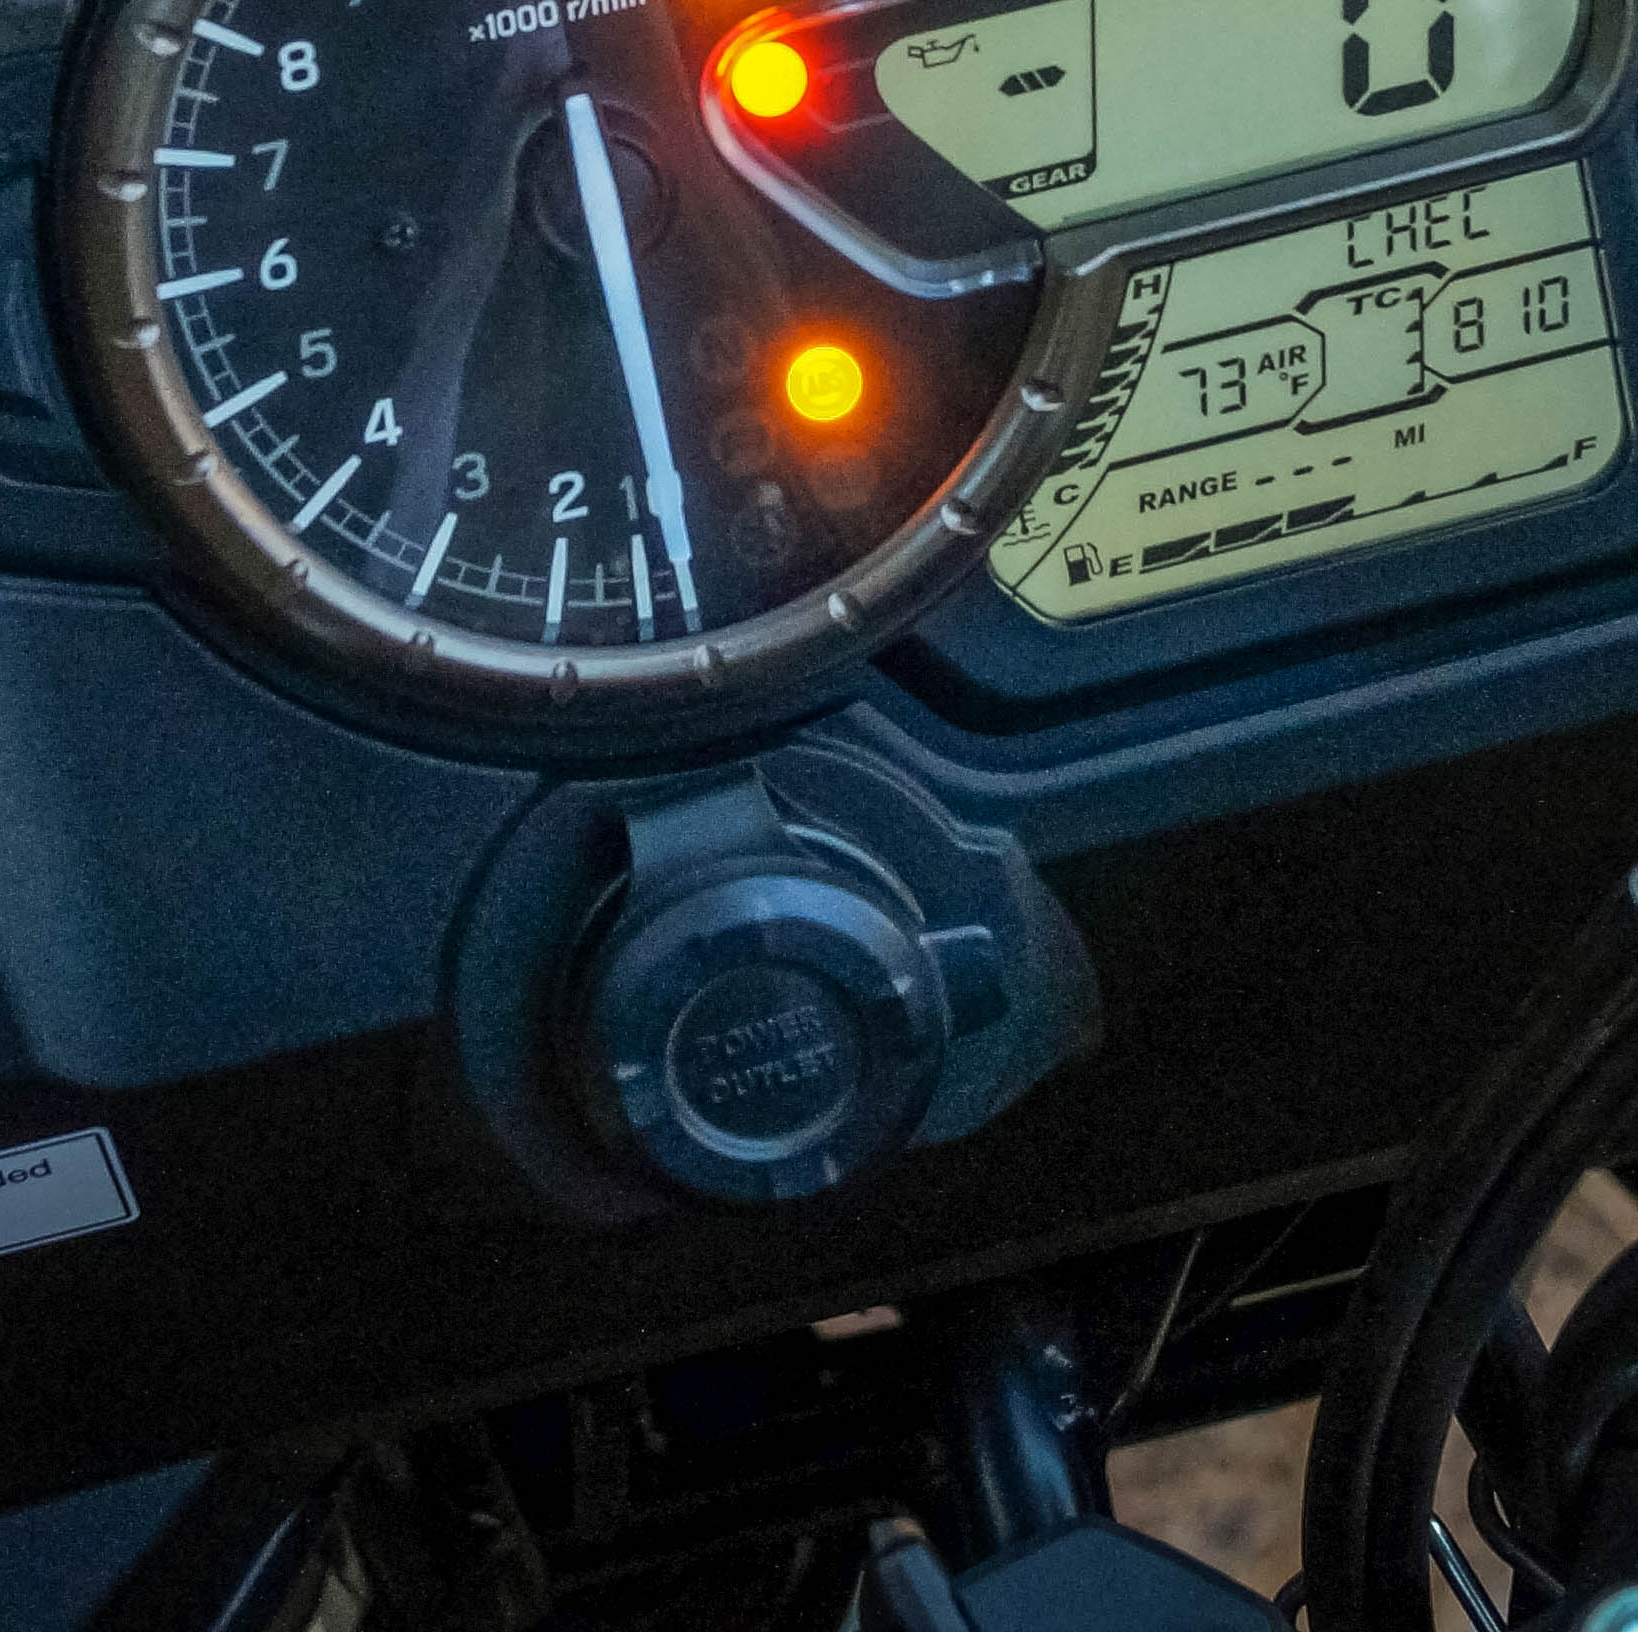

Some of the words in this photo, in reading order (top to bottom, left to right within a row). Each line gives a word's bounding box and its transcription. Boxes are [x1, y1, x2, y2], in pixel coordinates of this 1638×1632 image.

[278, 40, 319, 91] 8
[253, 139, 288, 190] 7
[1009, 163, 1088, 194] GEAR
[261, 238, 298, 290] 6
[1132, 272, 1161, 301] H
[1346, 286, 1402, 316] TC
[299, 329, 337, 378] 5
[1179, 358, 1247, 418] 73
[1256, 344, 1307, 376] AIR
[363, 398, 403, 446] 4
[1394, 425, 1426, 450] MI
[1572, 436, 1598, 461] F
[452, 453, 490, 500] 3
[549, 471, 588, 522] 2
[619, 475, 637, 520] 1
[1053, 483, 1080, 506] C
[1138, 471, 1238, 514] RANGE
[1109, 554, 1134, 577] E
